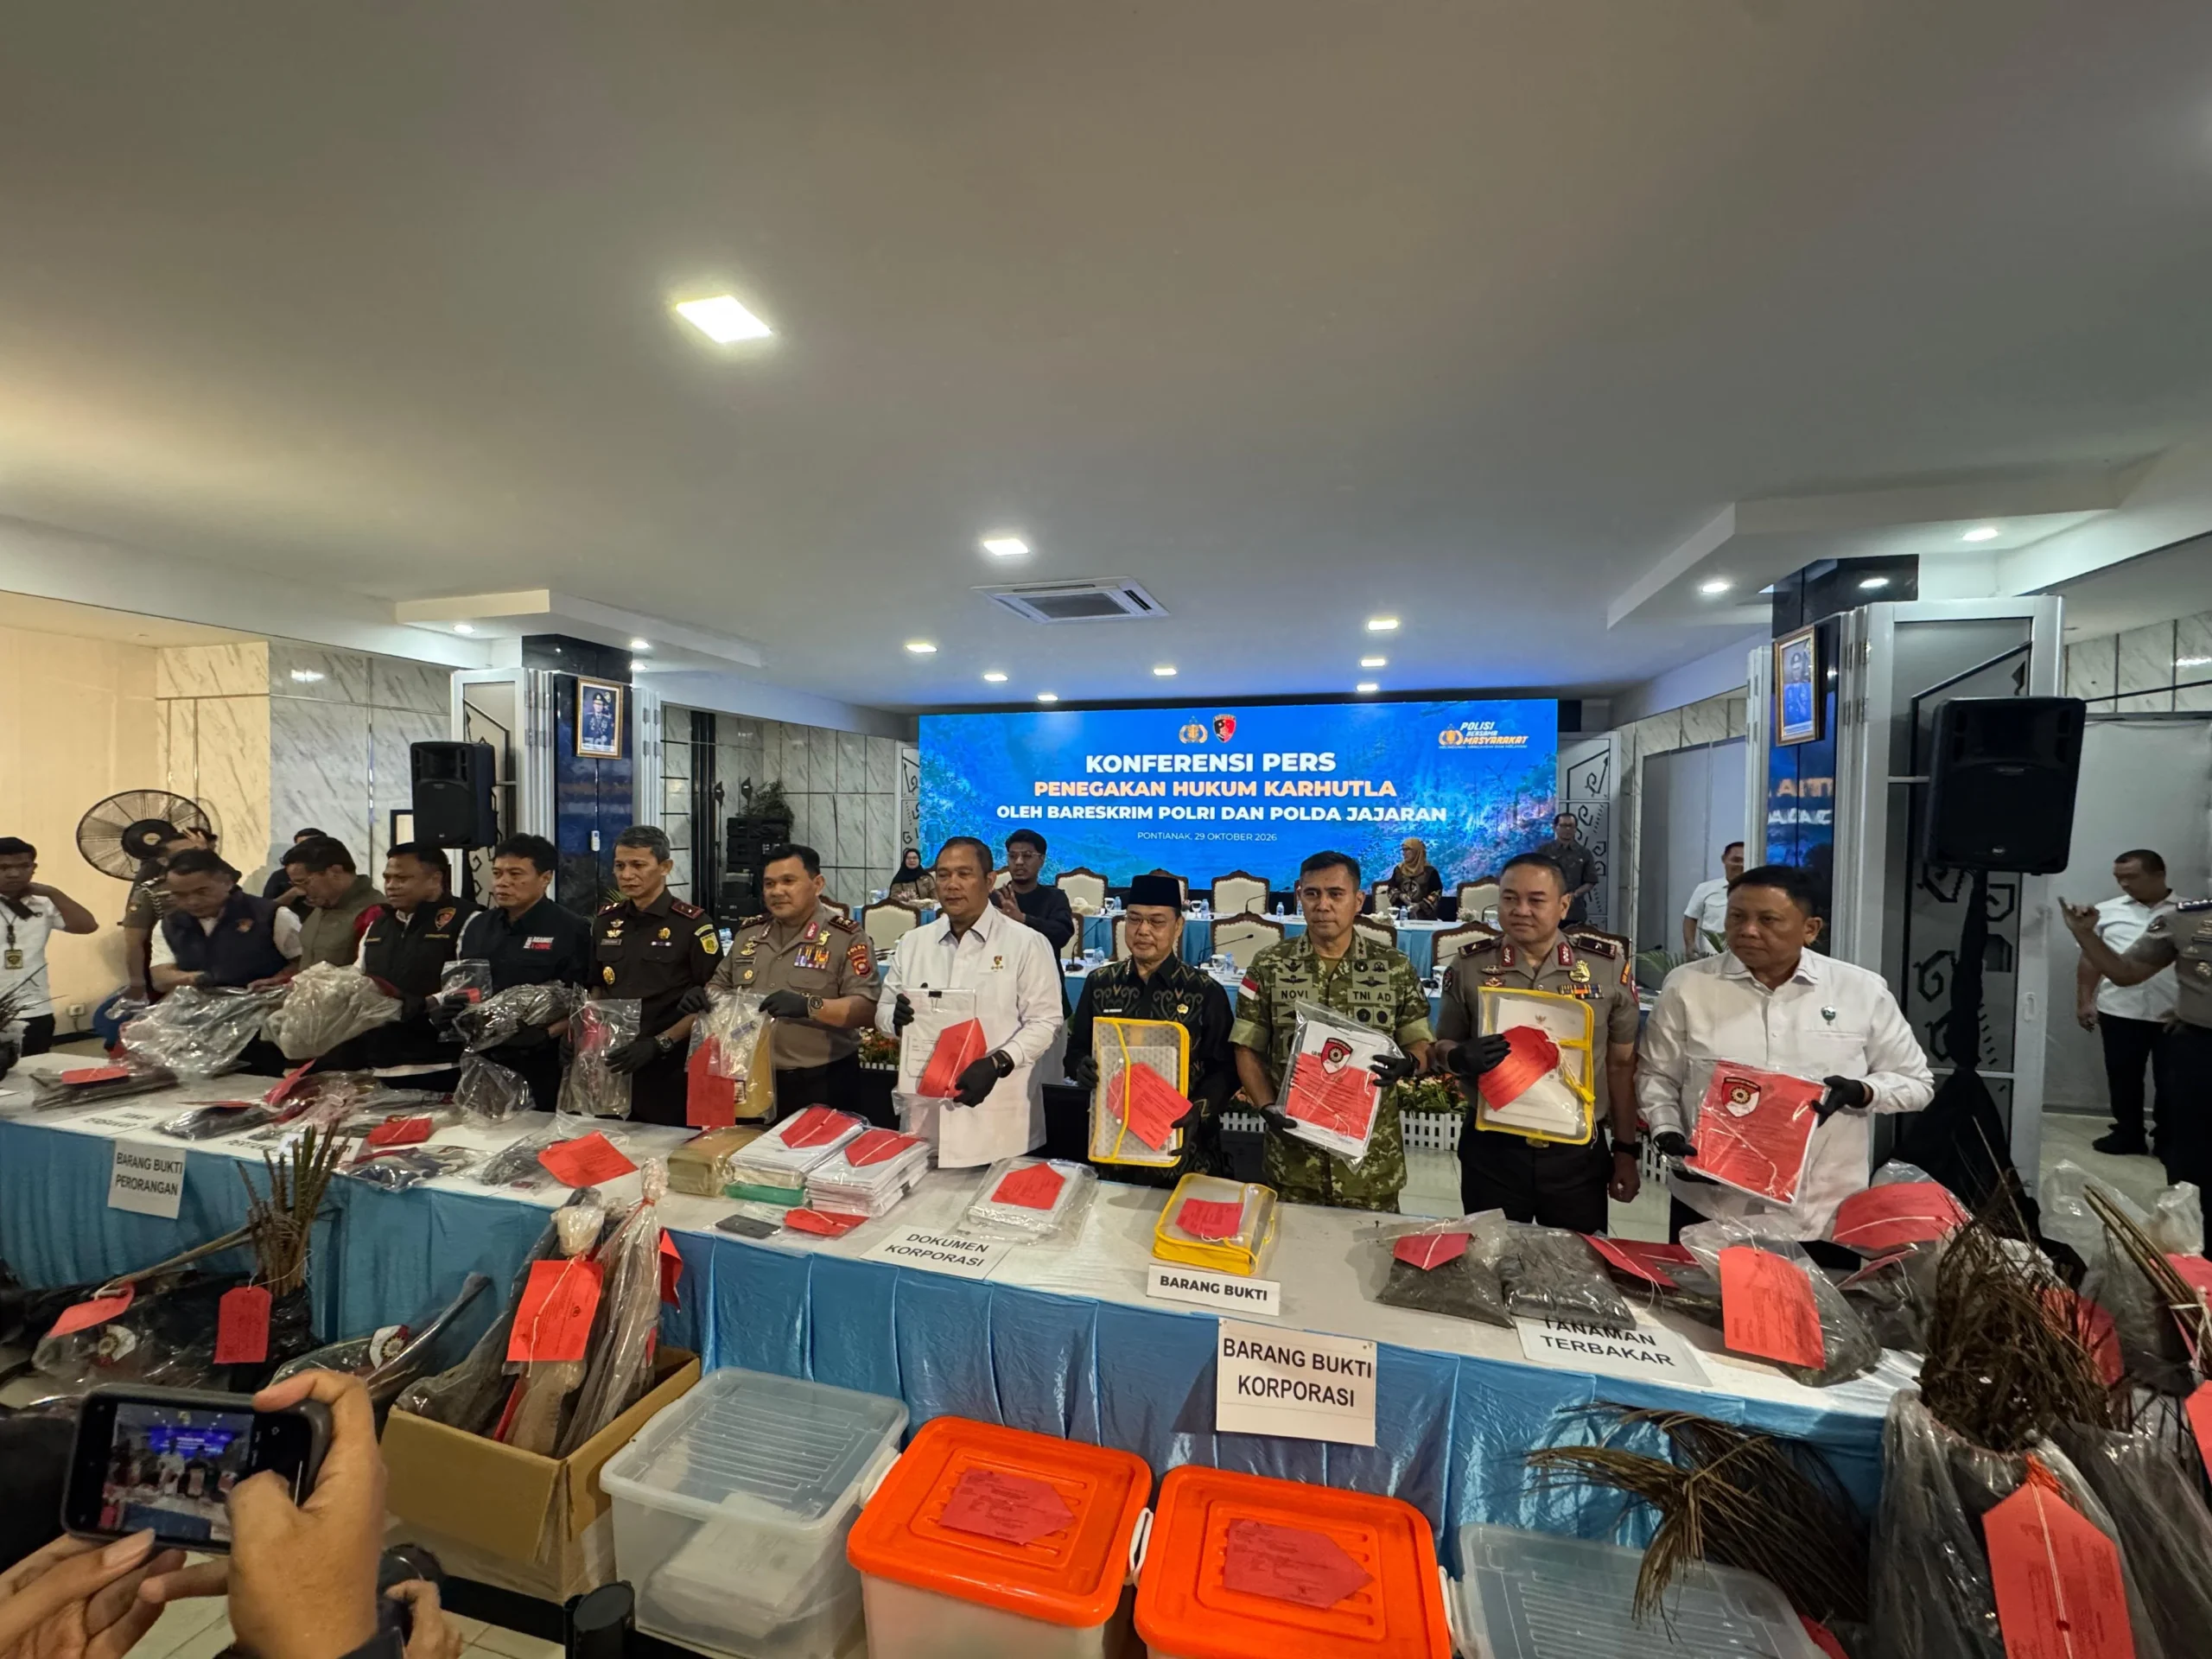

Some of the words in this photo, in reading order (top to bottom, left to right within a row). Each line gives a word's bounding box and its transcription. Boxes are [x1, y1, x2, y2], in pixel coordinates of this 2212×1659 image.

[1460, 721, 1495, 731] POLISI
[1463, 736, 1529, 745] MASYARAKAT
[1086, 753, 1253, 773] KONFERENSI
[1262, 752, 1336, 772] PERS
[1034, 781, 1166, 797] PENEGAKAN
[1173, 781, 1257, 797] HUKUM
[1264, 780, 1397, 797] KARHUTLA
[996, 805, 1042, 819] OLEH
[1047, 806, 1153, 820] BARESKRIM
[1159, 806, 1215, 820] POLRI
[1221, 807, 1264, 820] DAN
[1270, 807, 1342, 822] POLDA
[1346, 807, 1447, 822] JAJARAN
[1137, 831, 1192, 840] PONTIANAK,
[1207, 832, 1253, 841] OKTOBER
[1255, 833, 1278, 842] 2026
[1281, 989, 1309, 1000] NOVI
[1352, 991, 1370, 1001] TNI
[1376, 993, 1392, 1002] AD
[116, 1152, 152, 1171] BARANG
[153, 1159, 183, 1175] BUKTI
[115, 1173, 179, 1196] PERORANGAN
[906, 1233, 990, 1254] DOKUMEN
[884, 1244, 985, 1268] KORPORASI
[1160, 1274, 1221, 1294] BARANG
[1224, 1284, 1268, 1301] BUKTI
[1544, 1317, 1657, 1347] TANAMAN
[1224, 1338, 1306, 1368] BARANG
[1312, 1353, 1372, 1379] BUKTI
[1540, 1335, 1676, 1367] TERBAKAR
[1238, 1375, 1355, 1408] KORPORASI
